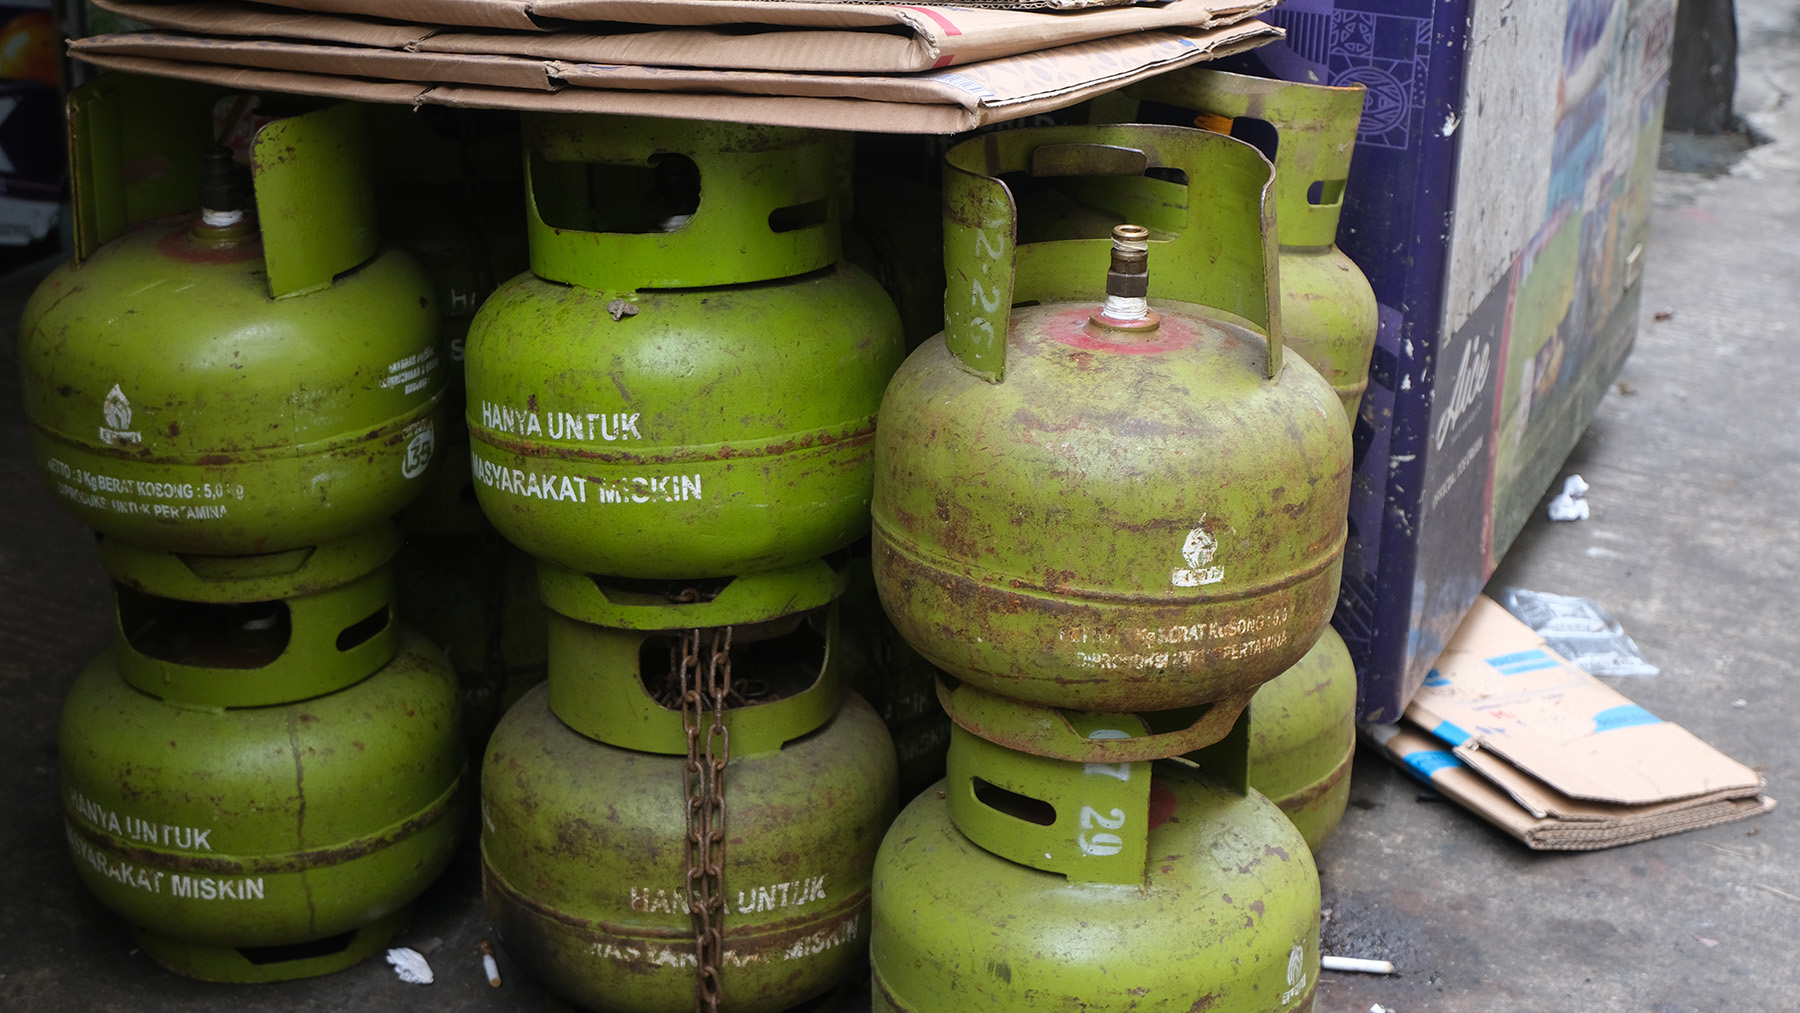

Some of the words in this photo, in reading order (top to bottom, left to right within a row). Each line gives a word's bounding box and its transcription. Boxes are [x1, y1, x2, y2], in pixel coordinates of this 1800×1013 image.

[481, 400, 542, 438] HANYA
[547, 411, 643, 442] UNTUK
[137, 481, 194, 500] KOSONG
[471, 450, 587, 503] MASYARAKAT
[599, 473, 703, 504] MISKIN
[69, 786, 123, 837] HANYA
[126, 815, 212, 852] UNTUK
[1078, 806, 1126, 856] 29
[172, 873, 265, 901] MISKIN
[738, 872, 828, 914] UNTUK
